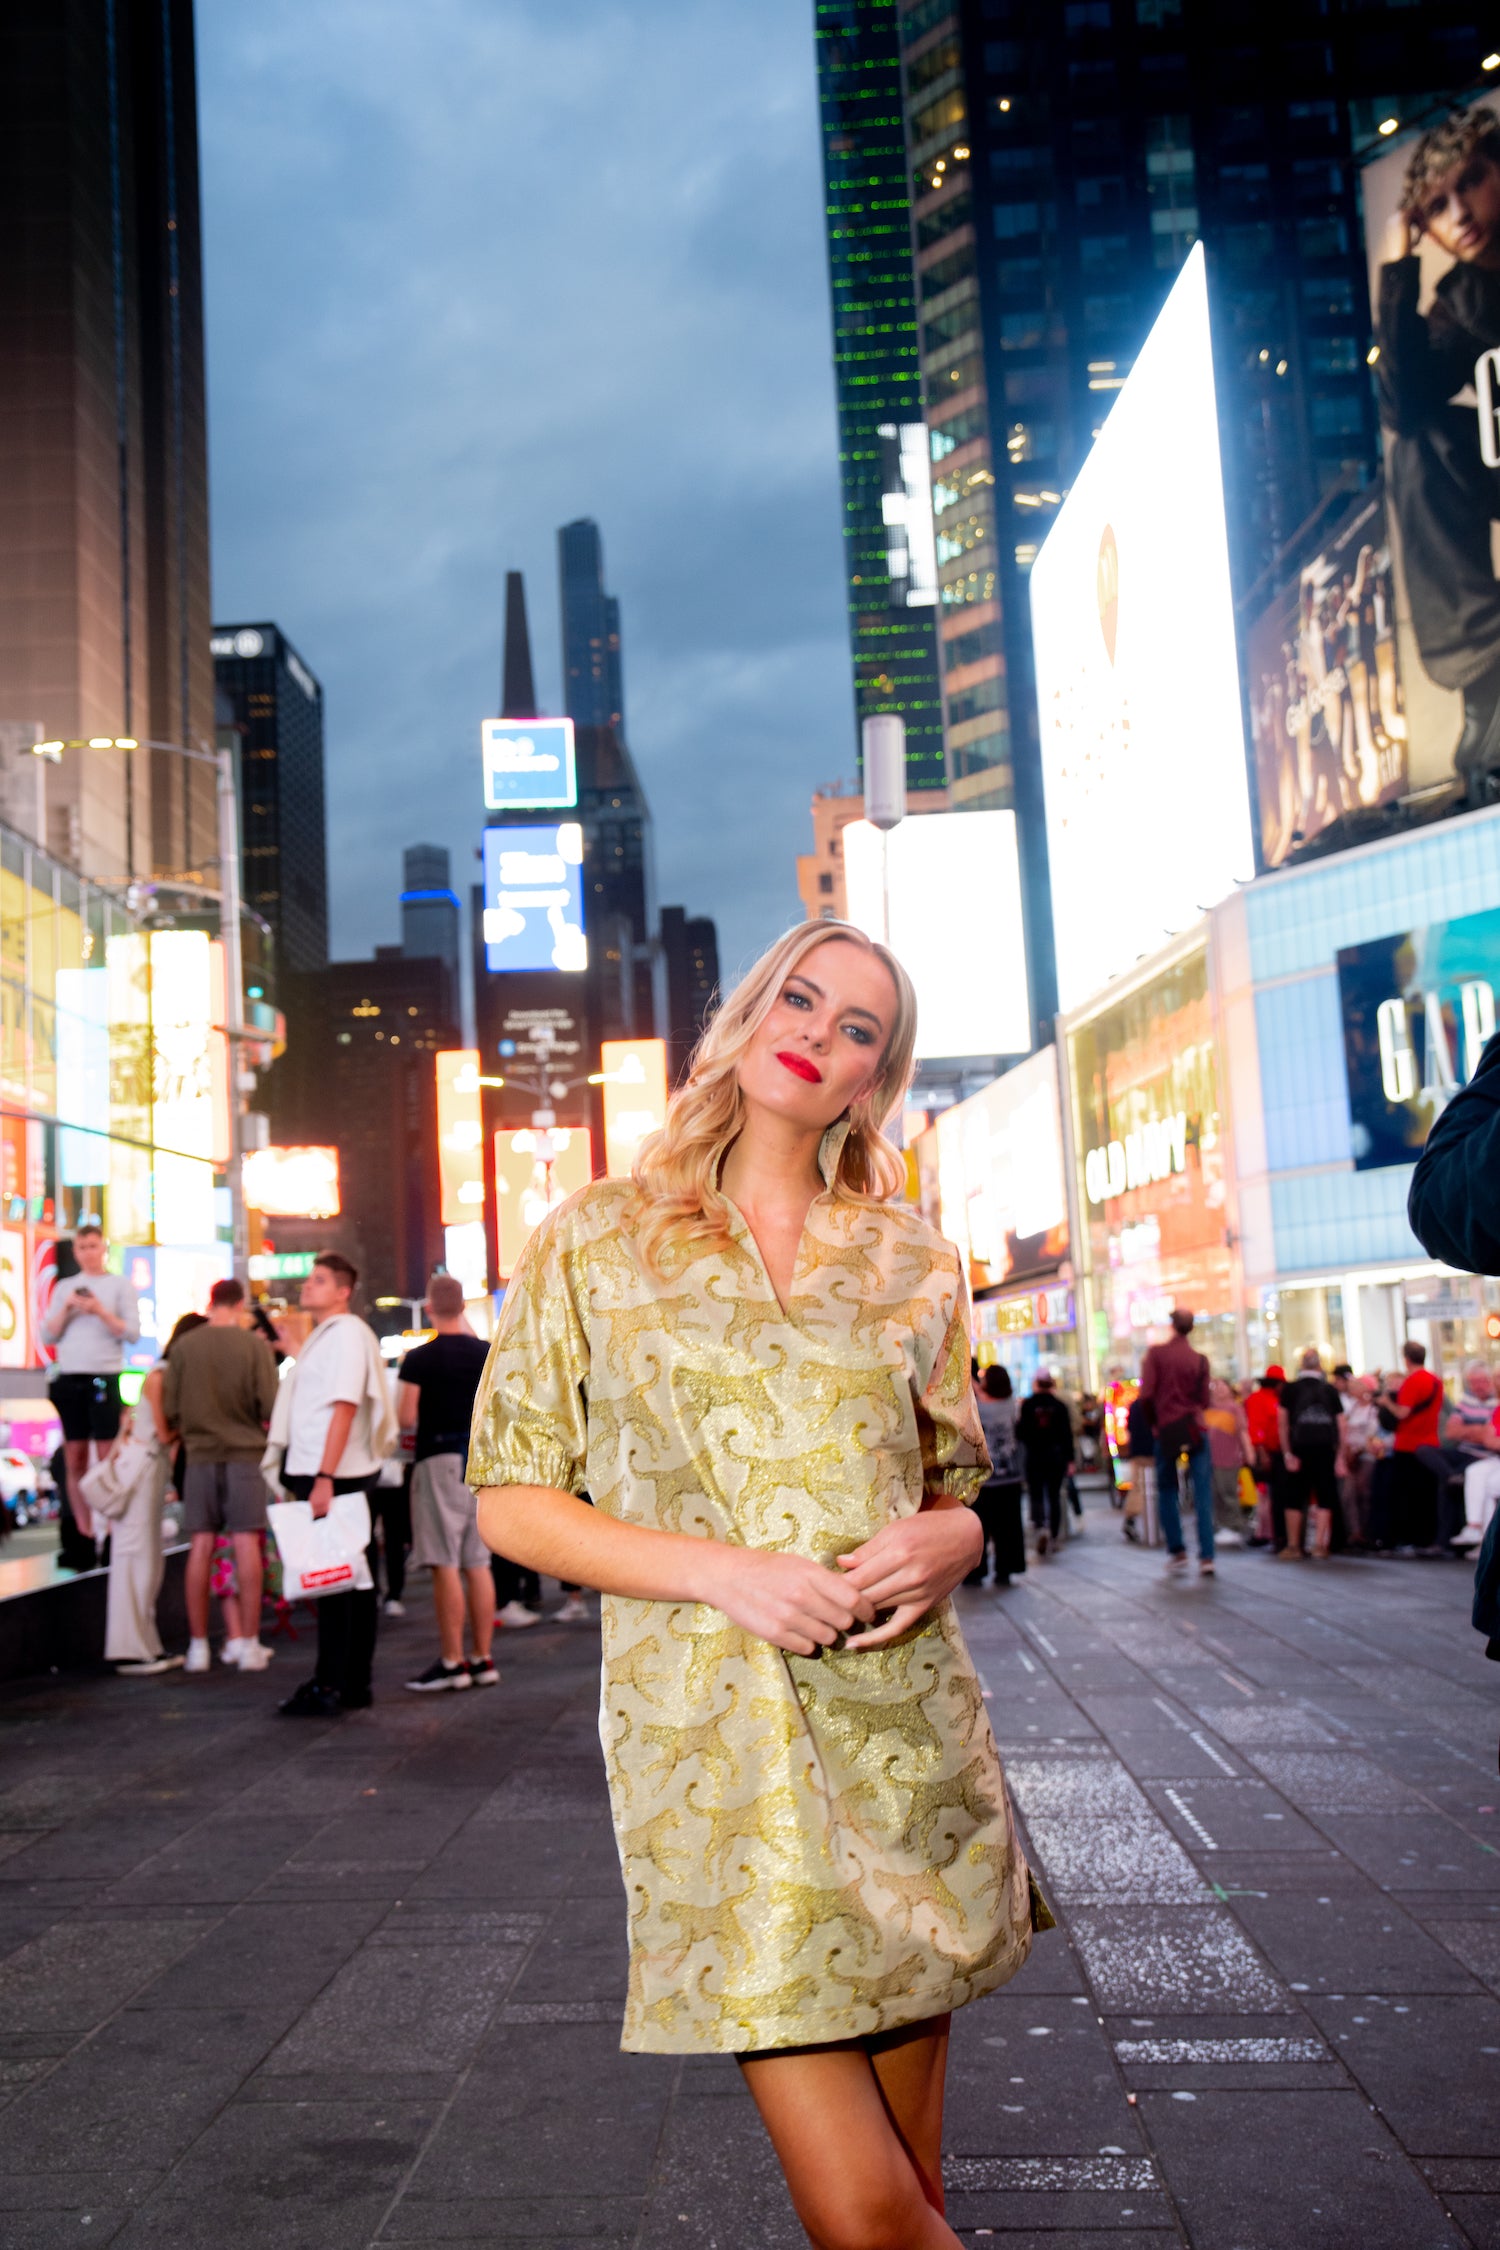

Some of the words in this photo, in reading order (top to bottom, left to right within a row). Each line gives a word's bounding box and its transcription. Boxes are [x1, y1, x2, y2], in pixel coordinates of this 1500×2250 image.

[1376, 980, 1496, 1103] GAP
[1086, 1140, 1126, 1204] OLD
[1125, 1111, 1187, 1190] NAVY
